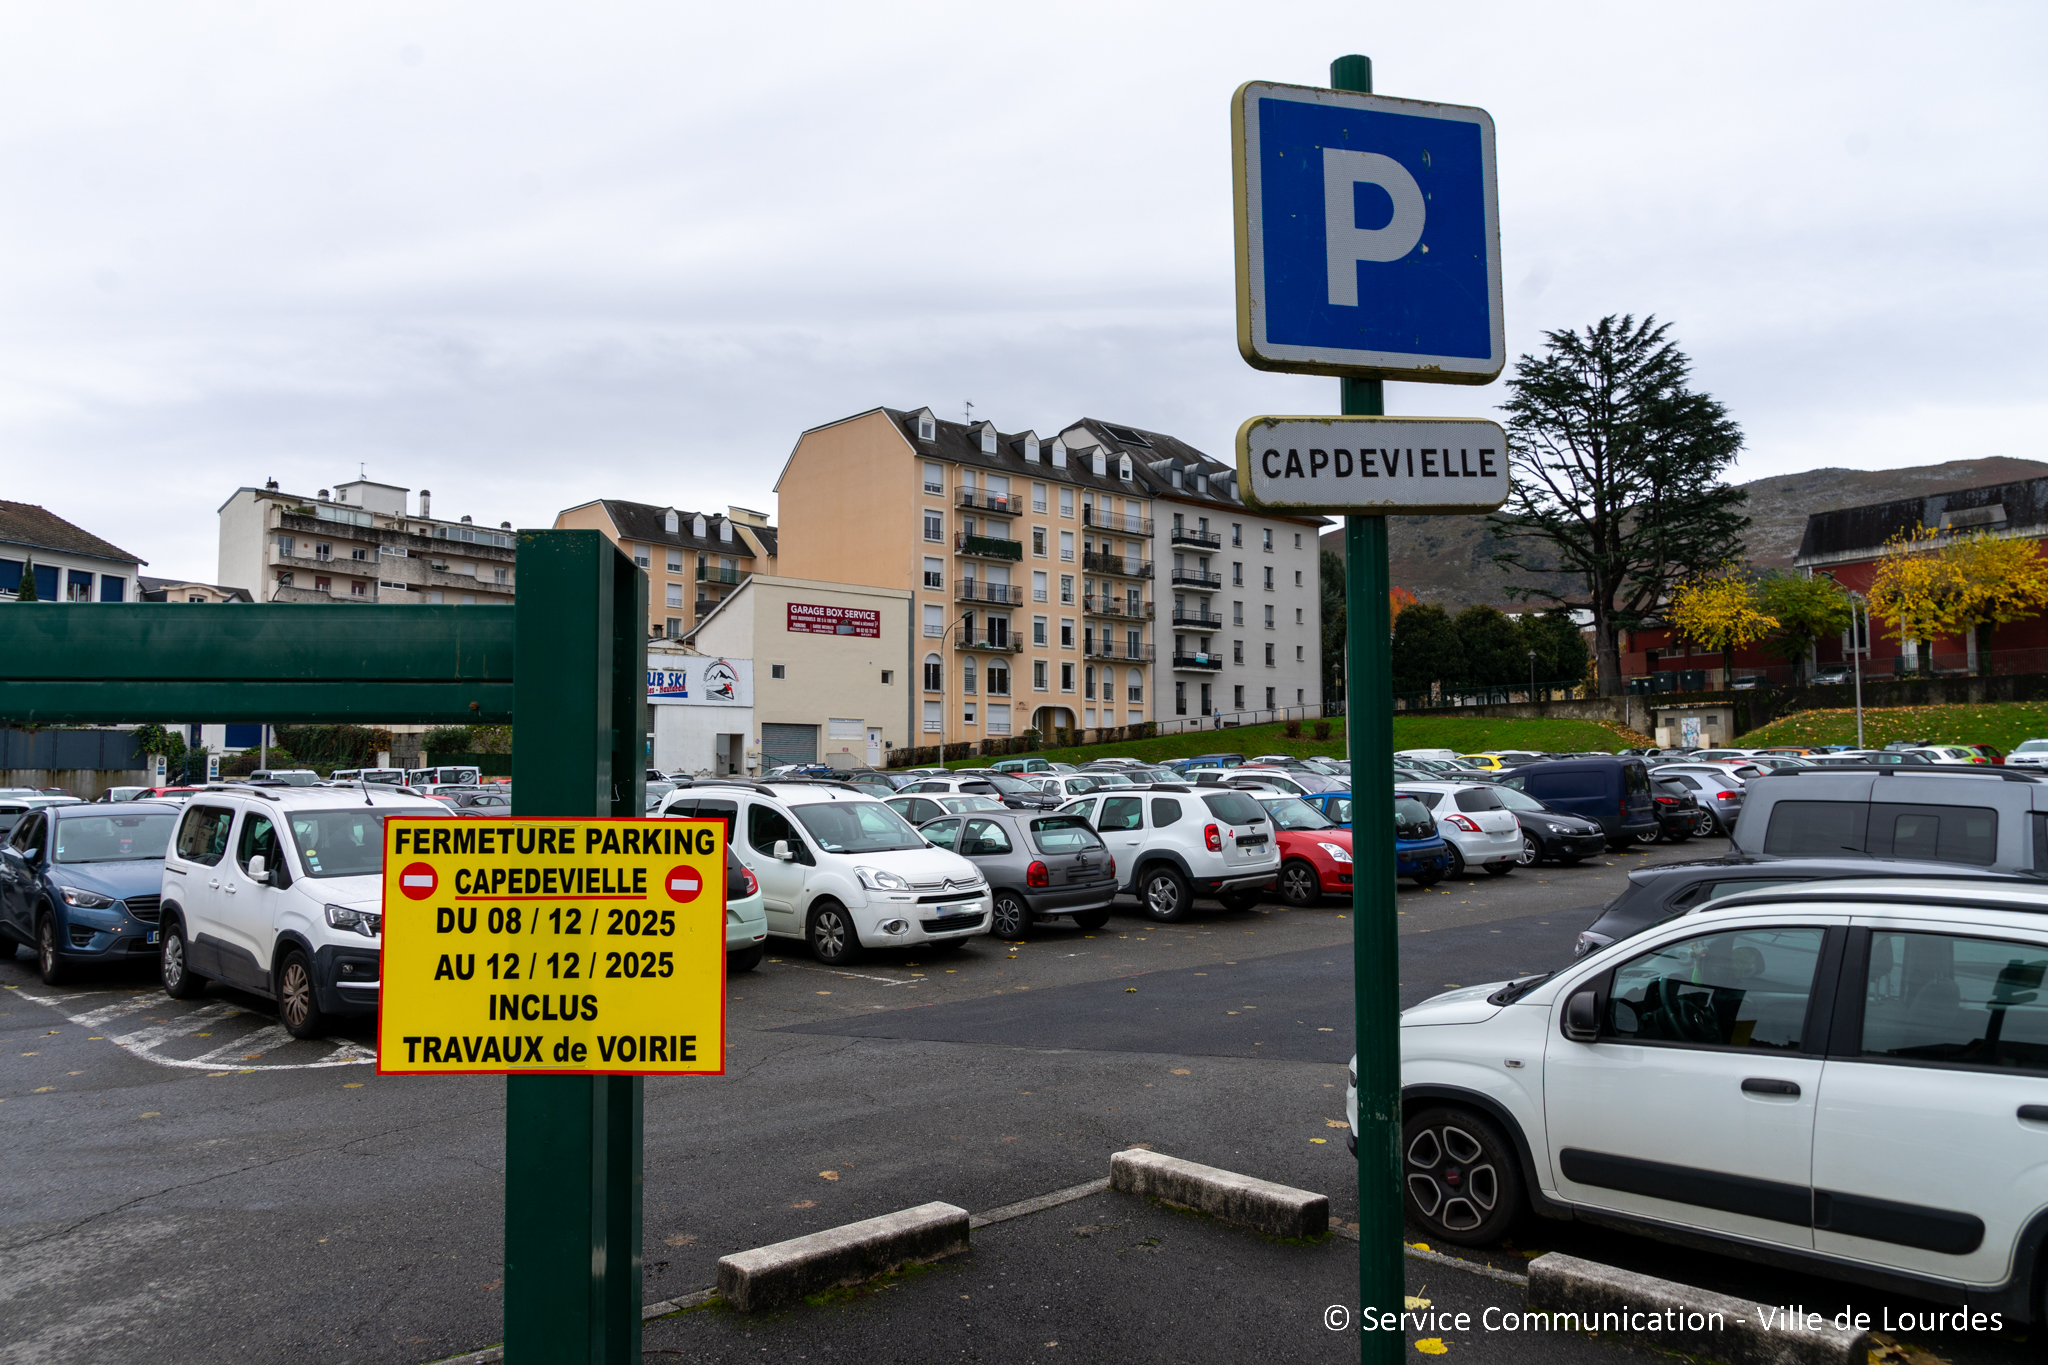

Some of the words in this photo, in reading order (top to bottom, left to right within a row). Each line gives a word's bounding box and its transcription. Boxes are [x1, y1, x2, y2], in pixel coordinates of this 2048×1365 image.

[1322, 147, 1426, 307] P
[1261, 447, 1497, 479] CAPDEVIELLE
[790, 605, 825, 616] GARAGE
[826, 607, 843, 617] BOX
[844, 609, 876, 621] SERVICE
[647, 671, 664, 686] UB
[667, 672, 687, 687] SKI
[395, 828, 576, 855] FERMETURE
[586, 828, 715, 856] PARKING
[455, 867, 647, 895] CAPEDEVIELLE
[436, 907, 477, 934] DU
[488, 907, 521, 934] 08
[530, 907, 539, 934] /
[549, 908, 582, 935] 12
[590, 908, 599, 935] /
[607, 909, 676, 937] 2025
[434, 953, 475, 981] AU
[486, 952, 520, 979] 12
[529, 952, 537, 979] /
[546, 952, 580, 979] 12
[589, 951, 597, 979] /
[605, 951, 674, 979] 2025
[489, 994, 599, 1021] INCLUS
[403, 1036, 544, 1063] TRAVAUX
[553, 1036, 587, 1063] de
[598, 1035, 697, 1062] VOIRIE
